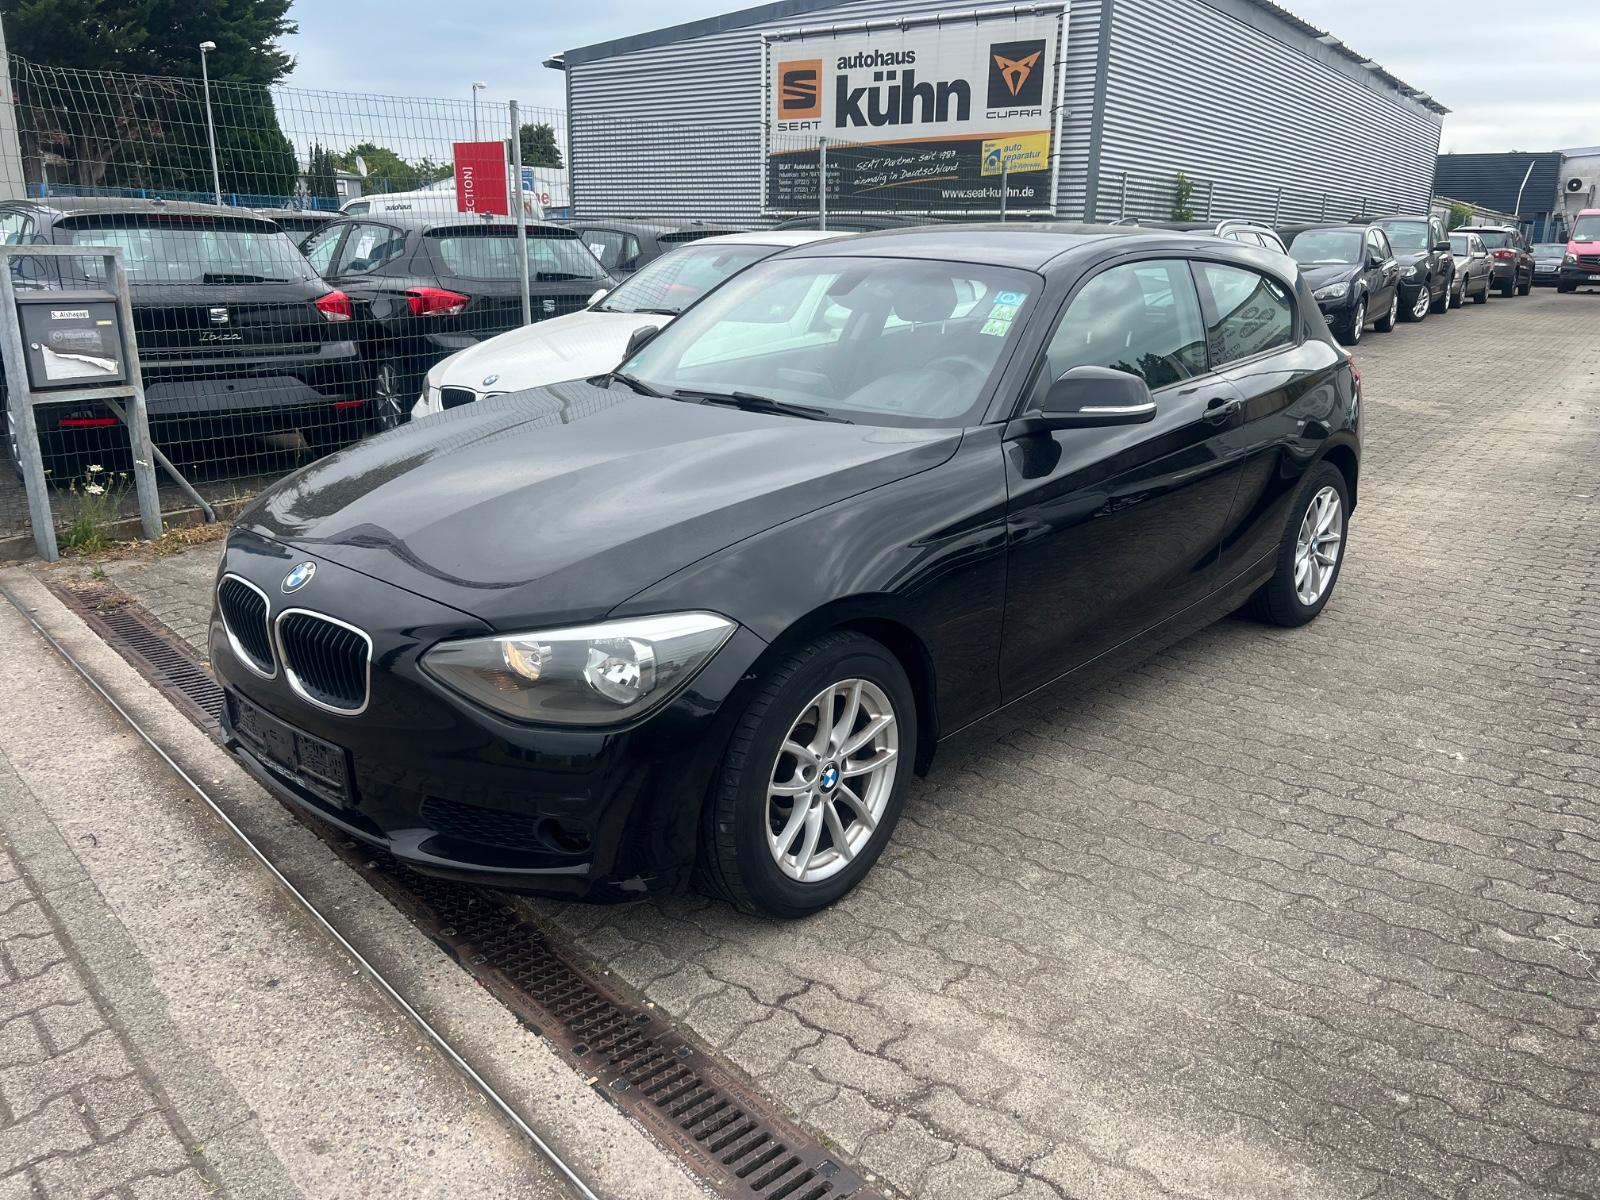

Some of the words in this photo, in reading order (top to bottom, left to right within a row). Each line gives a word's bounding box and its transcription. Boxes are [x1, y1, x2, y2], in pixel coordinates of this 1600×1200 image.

[837, 49, 916, 70] autohaus
[835, 68, 972, 128] kühn
[985, 108, 1042, 119] CUPRA
[777, 120, 822, 132] SEAT
[1004, 143, 1023, 153] auto
[883, 155, 916, 167] Partner
[918, 150, 937, 162] seit
[853, 172, 888, 186] einmalig
[889, 171, 898, 180] in
[899, 162, 960, 180] Deutschland
[941, 186, 1035, 200] www.seat-kuhn.de
